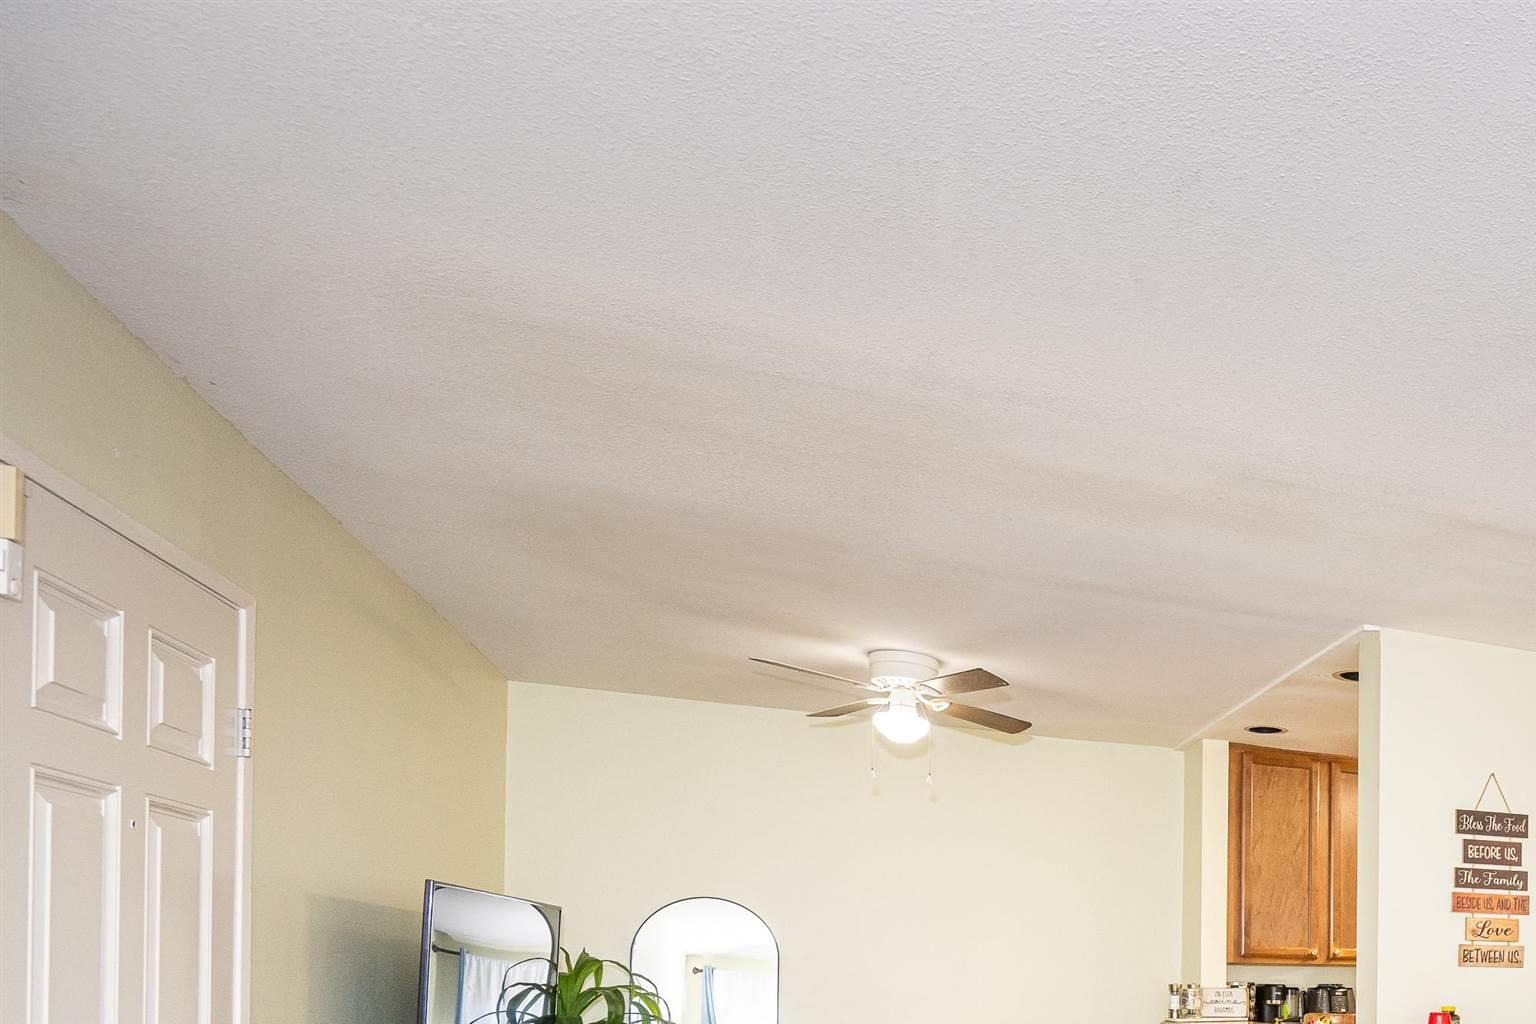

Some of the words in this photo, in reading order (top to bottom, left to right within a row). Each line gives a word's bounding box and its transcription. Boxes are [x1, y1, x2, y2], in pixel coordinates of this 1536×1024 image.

[1459, 814, 1483, 830] Bless
[1485, 815, 1503, 832] The
[1504, 817, 1527, 833] Food
[1468, 845, 1502, 860] BEFORE
[1504, 847, 1518, 862] US,
[1458, 869, 1481, 885] The
[1483, 871, 1523, 889] Family
[1456, 896, 1481, 910] BESIDE
[1496, 898, 1511, 911] AND
[1512, 898, 1527, 912] THE
[1472, 920, 1514, 939] Love
[1463, 948, 1505, 964] BETWEEN
[1507, 950, 1522, 964] US.
